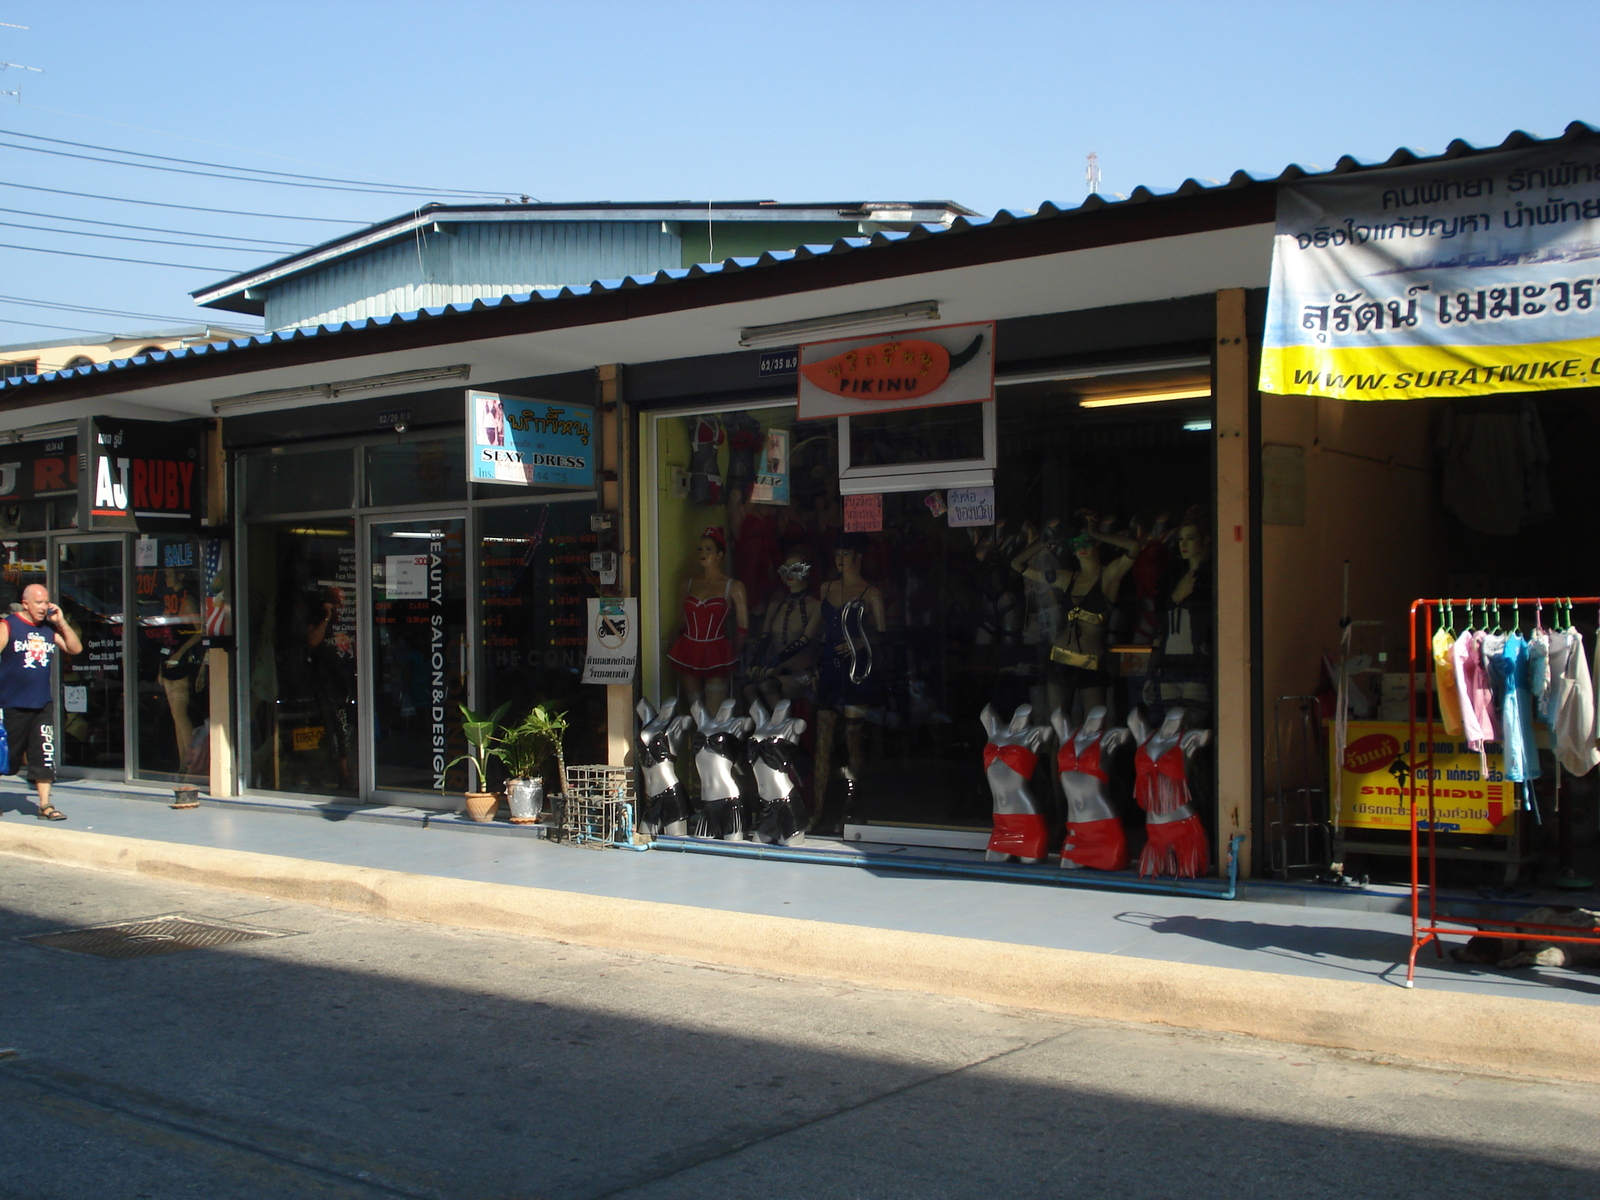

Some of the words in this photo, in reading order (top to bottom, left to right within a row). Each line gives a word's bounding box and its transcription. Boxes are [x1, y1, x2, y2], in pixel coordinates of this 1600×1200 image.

[1383, 177, 1493, 209] คนพัทยา
[1296, 214, 1490, 249] จริงใจแก้ปัญหา
[1302, 285, 1429, 343] สุรัตน์
[1439, 279, 1600, 324] เมฆะวร
[761, 358, 784, 372] 62/35
[839, 377, 917, 393] PIKINU
[508, 406, 590, 445] พริกขี้หนู
[483, 449, 524, 463] SEXY
[533, 453, 585, 469] DRESS
[95, 455, 130, 510] AJ
[133, 458, 194, 511] RUBY
[164, 543, 193, 568] SALE
[430, 529, 442, 606] BEAUTY
[409, 602, 429, 610] CLOSE
[14, 639, 56, 653] BANGKOK
[88, 640, 101, 649] Open
[89, 652, 101, 660] Close
[1346, 739, 1393, 769] รับแก้
